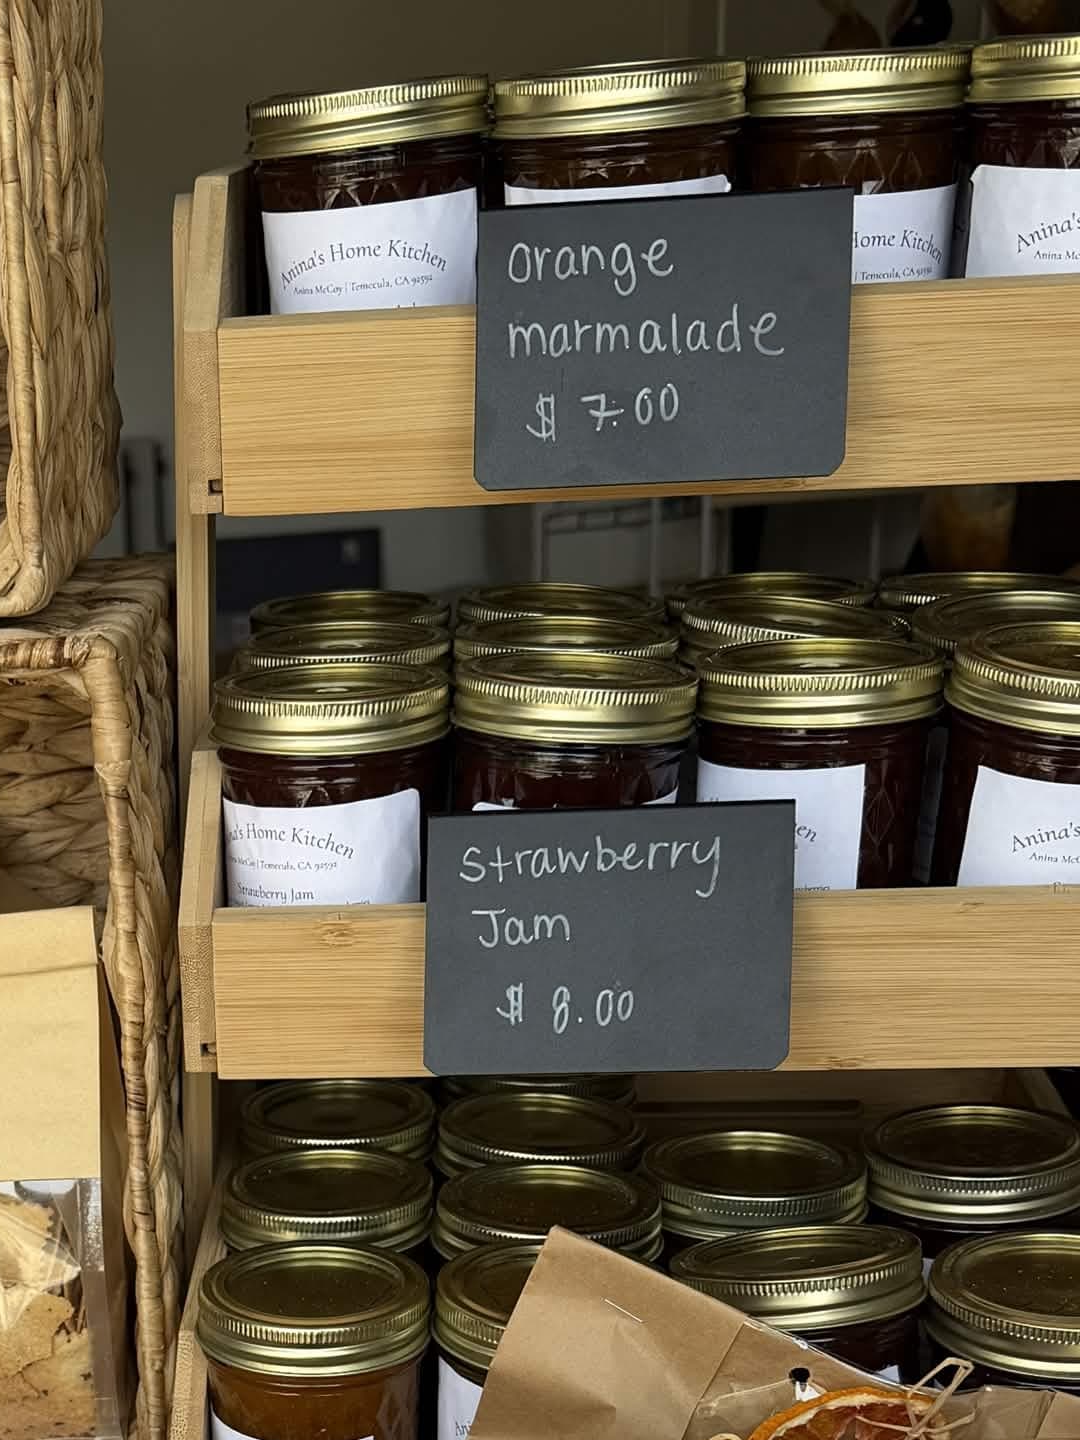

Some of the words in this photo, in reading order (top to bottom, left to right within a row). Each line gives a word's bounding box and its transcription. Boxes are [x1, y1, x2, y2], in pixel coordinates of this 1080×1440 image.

[901, 229, 944, 264] Kitchen
[1034, 251, 1062, 260] Anina
[280, 250, 325, 291] Anina's
[330, 242, 381, 262] Home
[387, 240, 447, 271] Kitchen
[903, 267, 915, 277] CA
[293, 286, 313, 295] Anina
[315, 285, 343, 296] McCoy
[395, 277, 408, 286] CA
[508, 302, 784, 358] marmalade
[247, 824, 285, 841] Home
[291, 828, 354, 859] Kitchen
[1029, 853, 1058, 863] Anina
[290, 888, 314, 902] Jam
[472, 908, 570, 948] Jam
